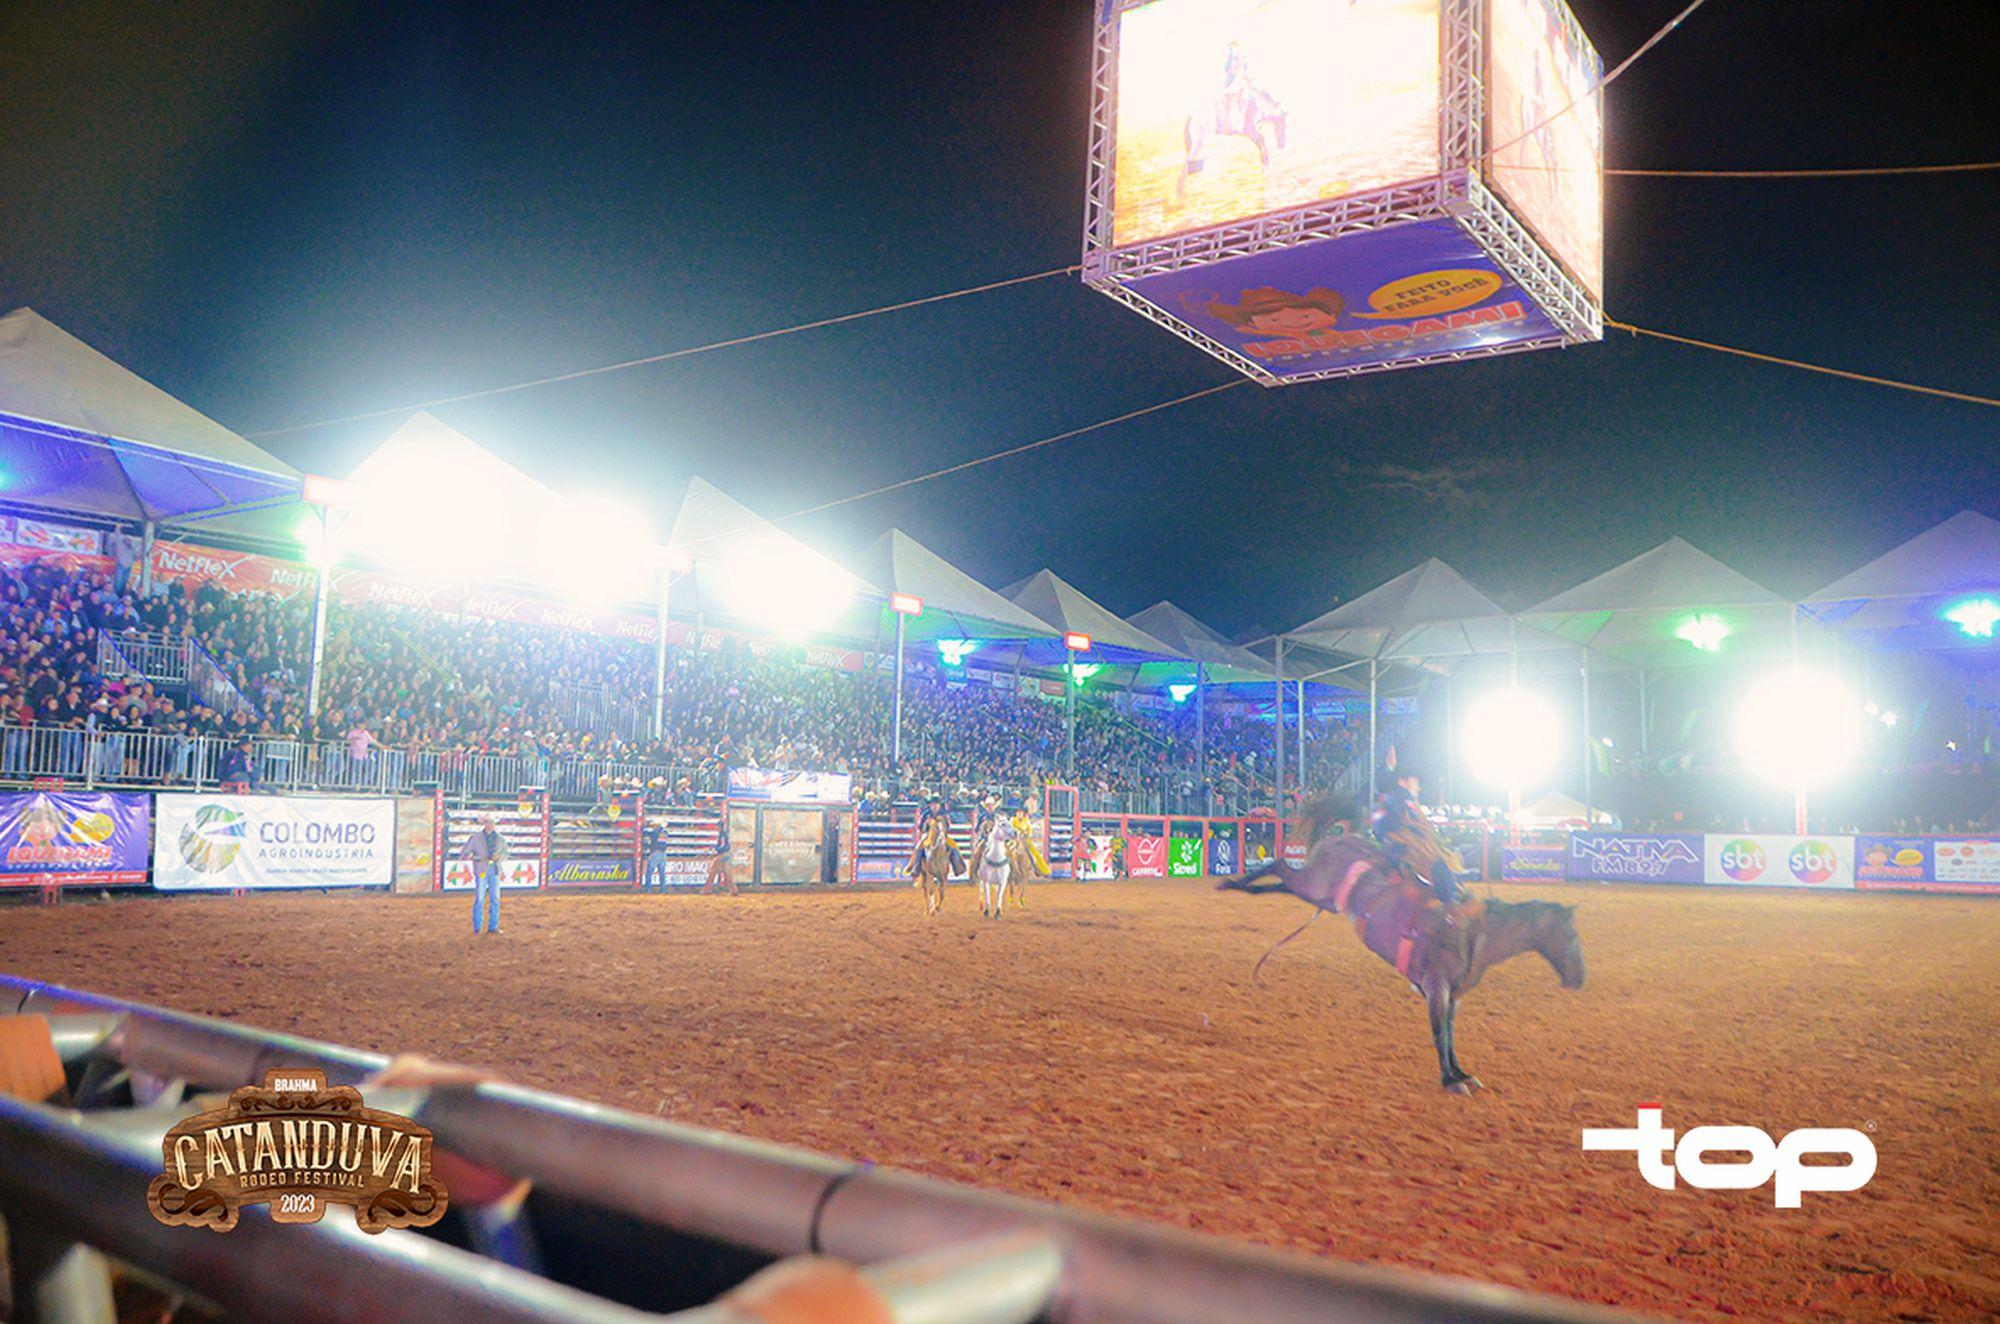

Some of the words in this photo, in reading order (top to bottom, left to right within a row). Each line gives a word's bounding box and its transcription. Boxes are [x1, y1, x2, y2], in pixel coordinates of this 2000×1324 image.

[1394, 279, 1451, 299] FEITO
[1384, 294, 1436, 312] PARA
[259, 822, 376, 844] COLOMBO
[258, 848, 374, 860] AGROINDUSTRIA
[1572, 836, 1700, 863] NATIVA
[1722, 844, 1764, 869] sbt
[1791, 845, 1835, 872] sbt
